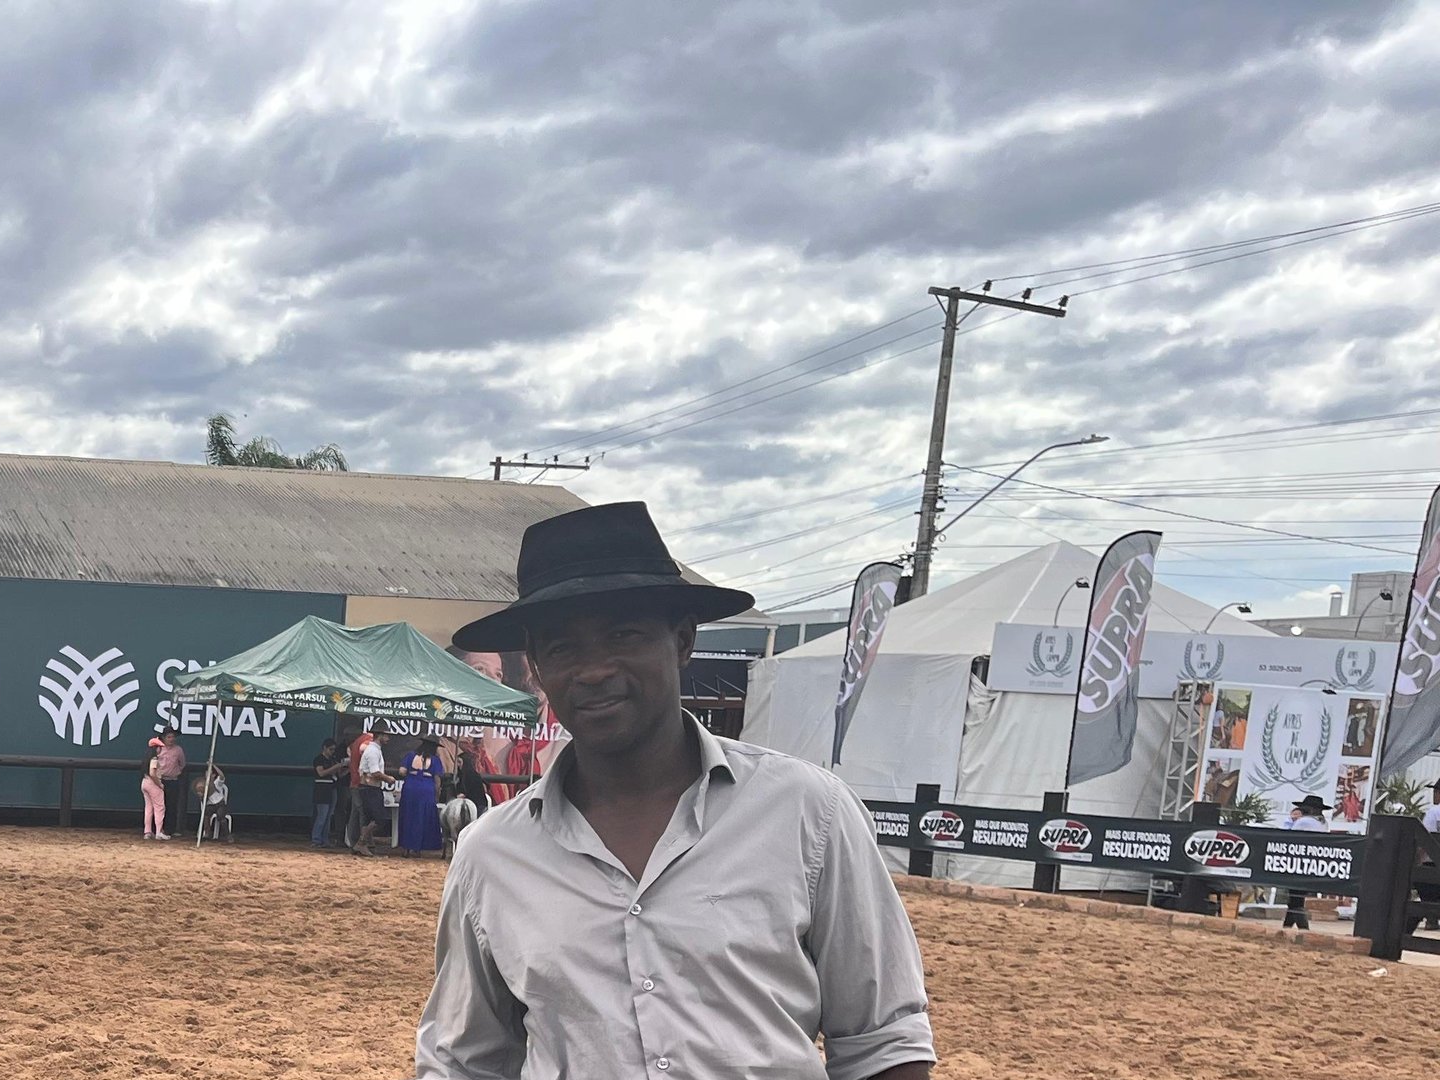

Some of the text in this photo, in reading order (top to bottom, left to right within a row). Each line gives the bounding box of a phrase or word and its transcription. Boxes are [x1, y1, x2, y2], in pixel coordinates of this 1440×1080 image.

[1081, 558, 1153, 708] SUPRA
[354, 697, 428, 711] SISTEMA FARSUL
[153, 700, 287, 738] SENAR
[921, 818, 961, 834] SUPRA
[1105, 829, 1121, 840] MAIS
[1122, 830, 1136, 842] QUE
[972, 829, 1028, 848] RESULTADOS!
[1041, 828, 1088, 845] SUPRA
[1102, 841, 1170, 862] RESULTADOS!
[1187, 839, 1245, 859] SUPRA
[1266, 842, 1353, 862] MAIS QUE PRODUTOS,
[1264, 855, 1351, 880] RESULTADOS!
